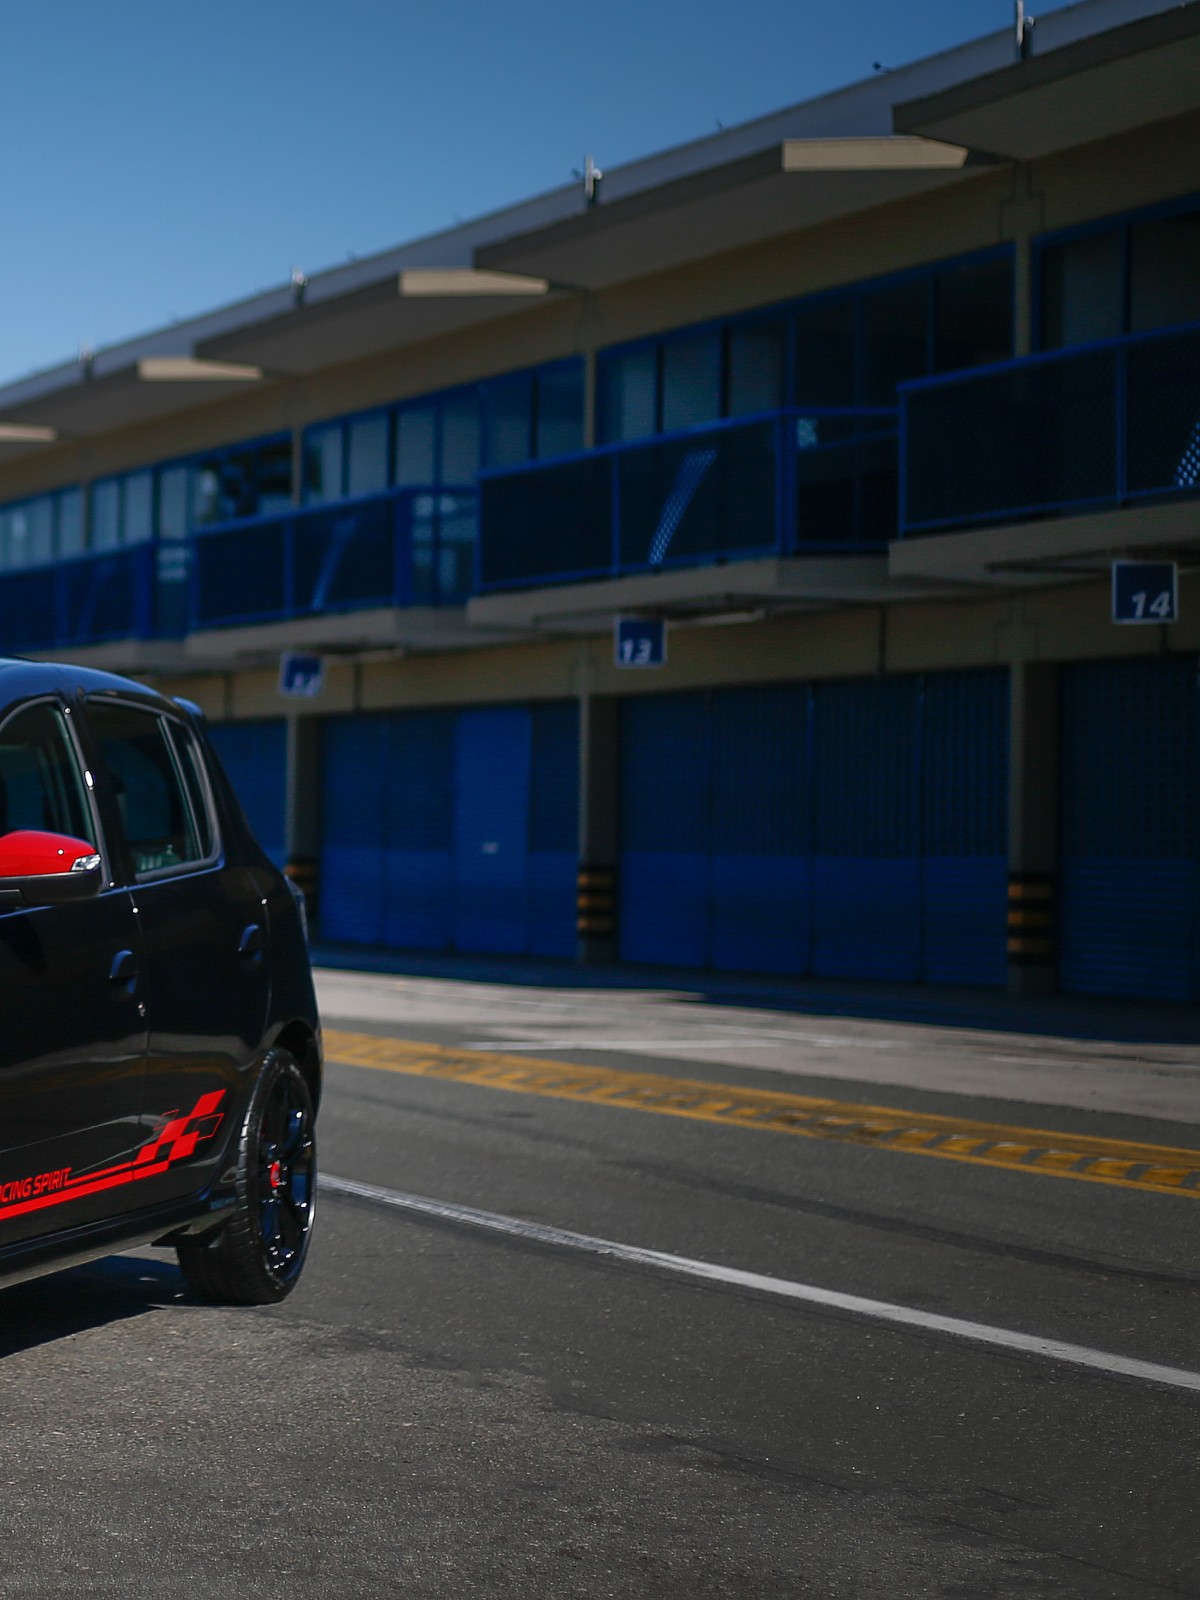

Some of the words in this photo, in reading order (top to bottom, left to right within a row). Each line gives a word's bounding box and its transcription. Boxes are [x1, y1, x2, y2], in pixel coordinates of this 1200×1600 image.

[1132, 591, 1172, 618] 14
[620, 638, 652, 666] 13
[33, 1167, 72, 1195] SPIRIT
